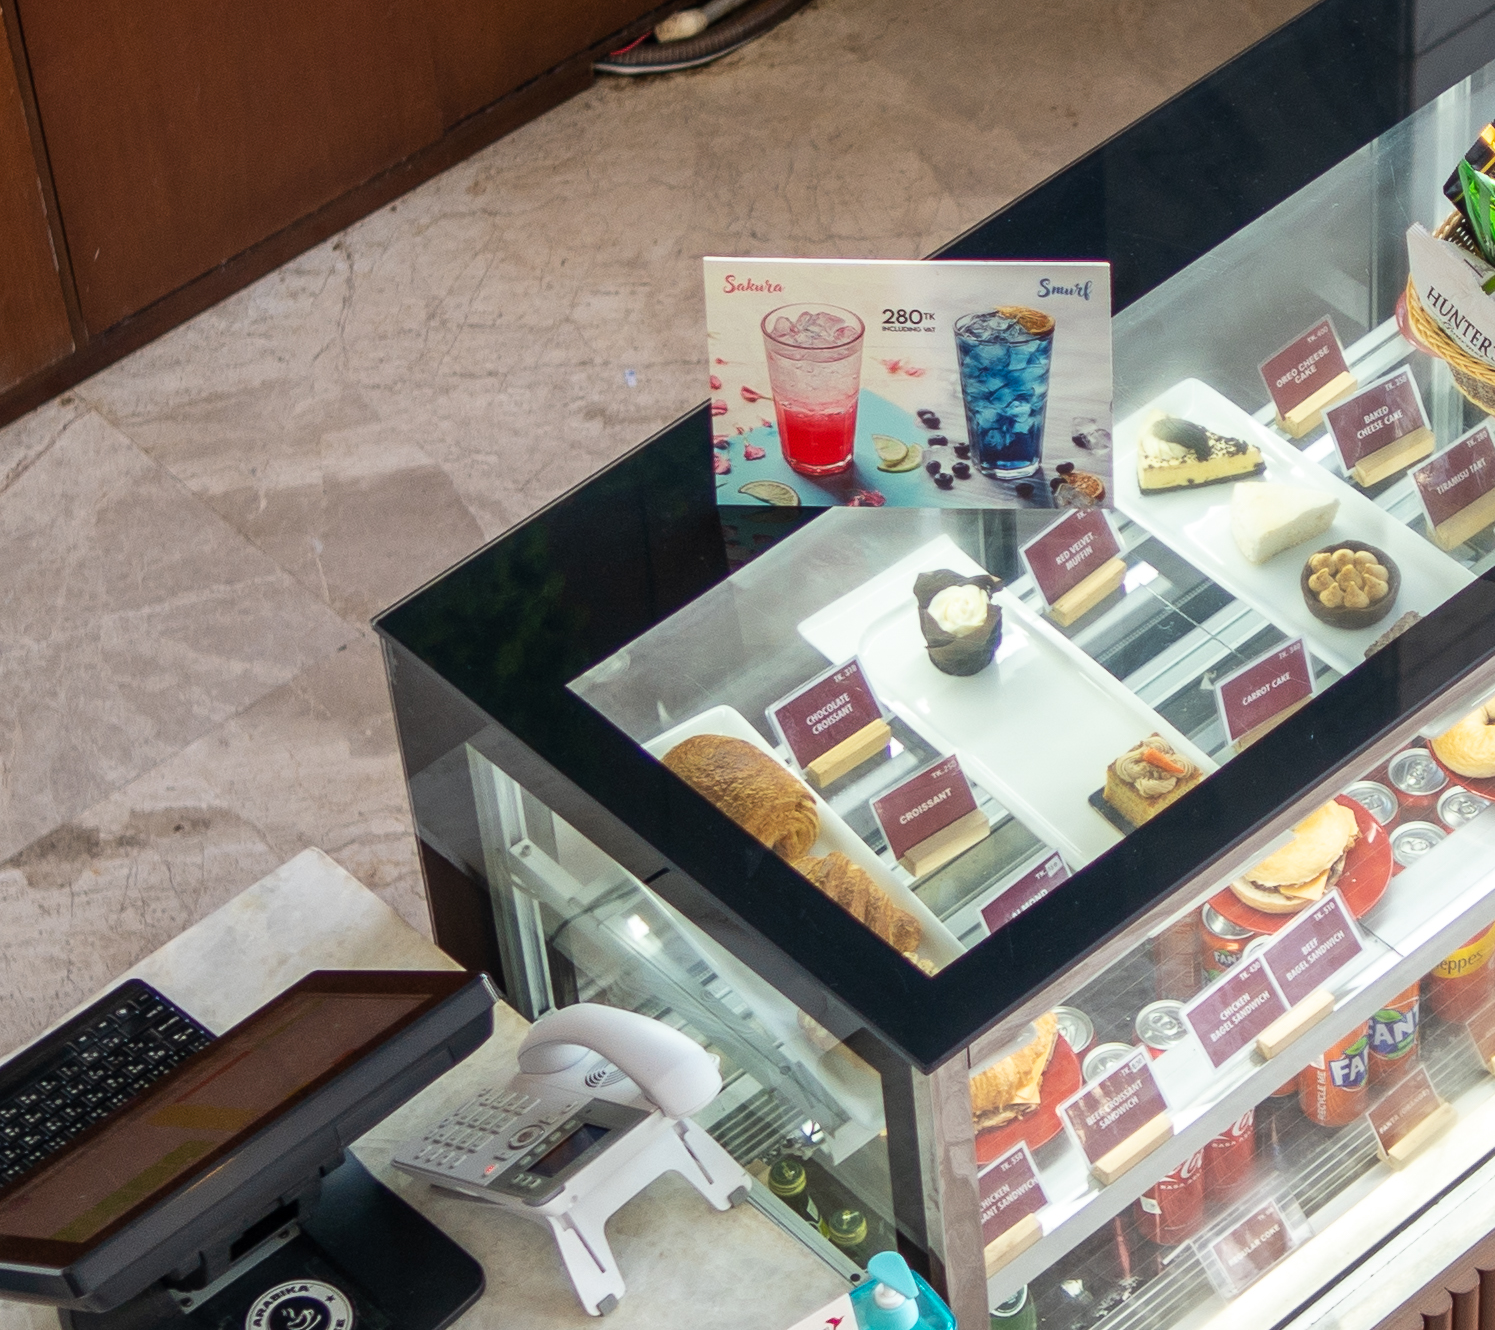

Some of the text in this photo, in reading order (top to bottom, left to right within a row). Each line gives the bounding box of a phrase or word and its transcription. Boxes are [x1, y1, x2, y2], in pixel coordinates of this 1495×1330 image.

[723, 274, 785, 295] Sakura
[1037, 277, 1093, 301] Smurf
[882, 326, 936, 334] INCLUDING VAT
[1275, 346, 1330, 388] OREO CHEESE
[1294, 364, 1318, 385] CAKE
[1356, 409, 1404, 440] CHEESE CAKE
[1363, 406, 1389, 424] BAKED
[1436, 458, 1487, 495] TIRAMISU TART
[1055, 532, 1094, 566] RED VELVET
[1065, 546, 1094, 572] MUFFIN
[1242, 671, 1292, 706] CARROT CAKE
[806, 692, 851, 726] CHOCOLATE
[811, 703, 854, 736] CROISSANT
[898, 787, 953, 825] CROISSANT
[1285, 929, 1345, 982] BAGEL SANDWICH
[1301, 936, 1320, 956] BEEF
[1210, 989, 1272, 1043] BAGEL SANDWICH
[1218, 992, 1252, 1022] CHICKEN
[1086, 1080, 1143, 1126] BEEF CROISSANT
[1099, 1096, 1140, 1129] SANDWICH
[1317, 1084, 1326, 1121] RECYCLE
[997, 1176, 1039, 1211] SANDWICH
[1259, 1222, 1281, 1242] COKE
[253, 1284, 310, 1328] ARABIKA
